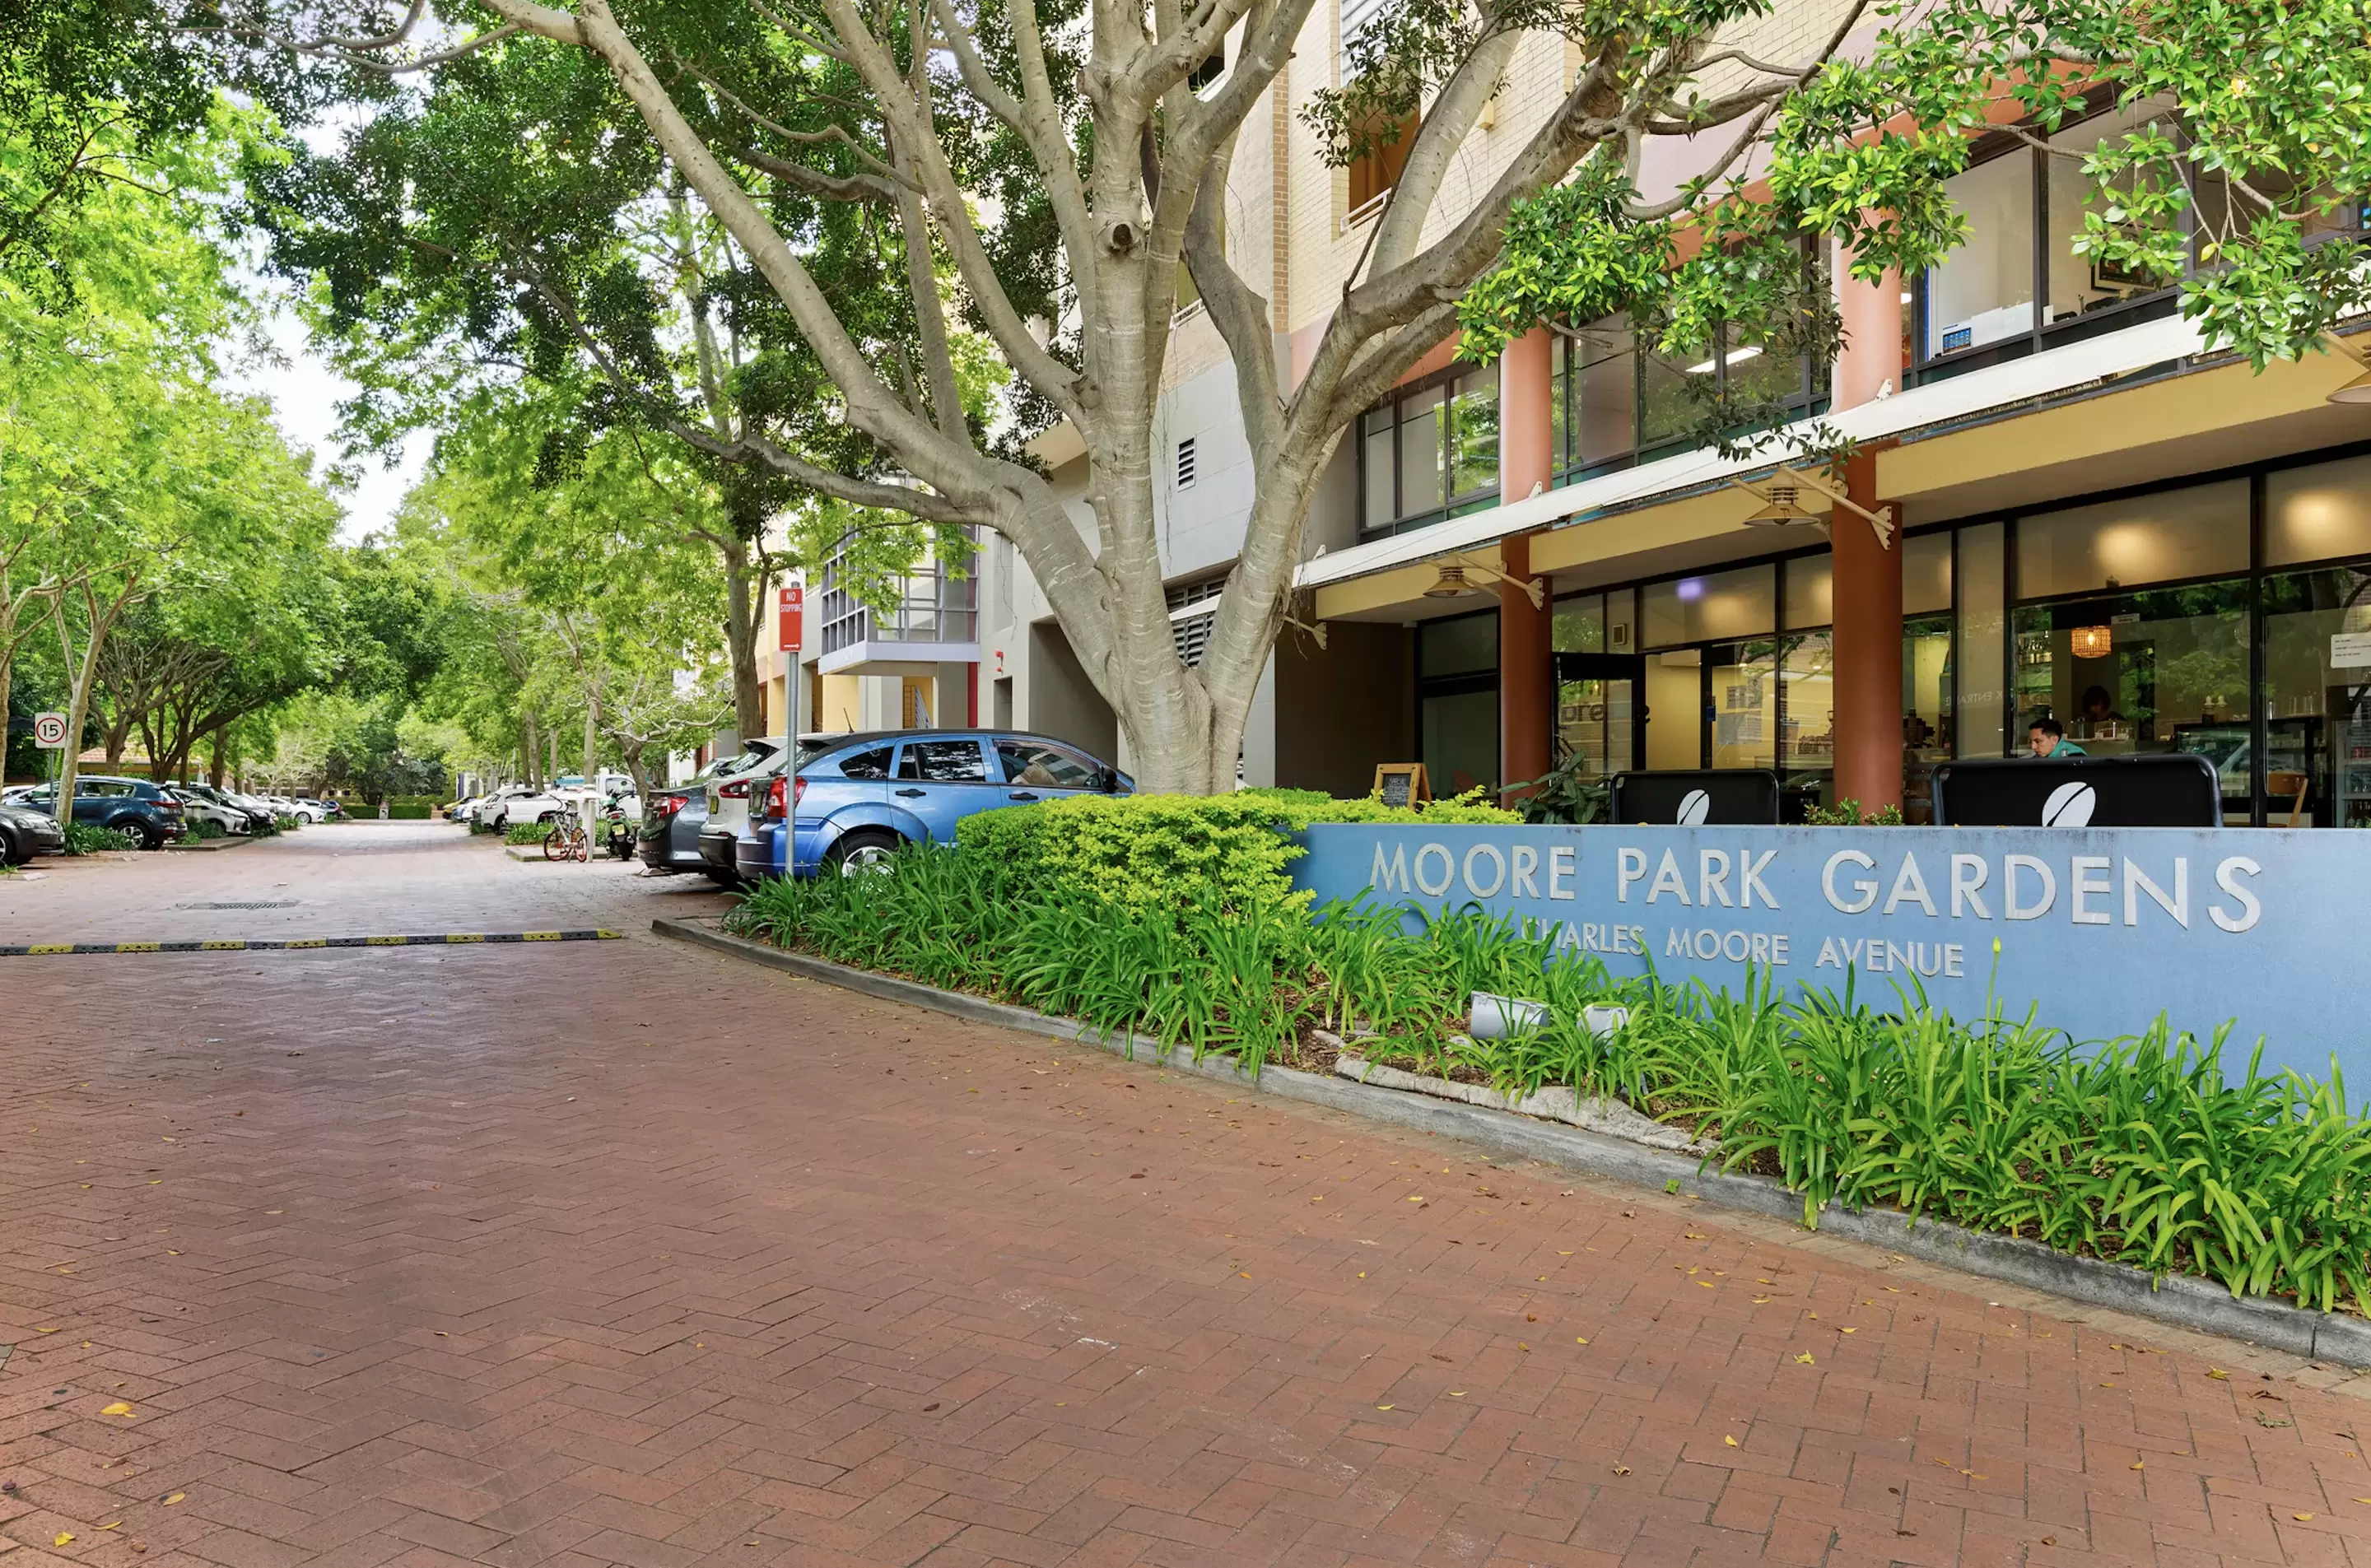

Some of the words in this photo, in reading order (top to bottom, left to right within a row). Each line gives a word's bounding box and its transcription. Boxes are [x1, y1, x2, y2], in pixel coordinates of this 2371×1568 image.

[786, 592, 797, 602] NO
[780, 603, 802, 612] STOPPING
[43, 724, 58, 737] 15
[1369, 841, 1576, 900] MOORE
[1617, 846, 1780, 910] PARK
[1821, 849, 2262, 933] GARDENS
[1665, 927, 1790, 966] MOORE
[1814, 937, 1963, 978] AVENUE
